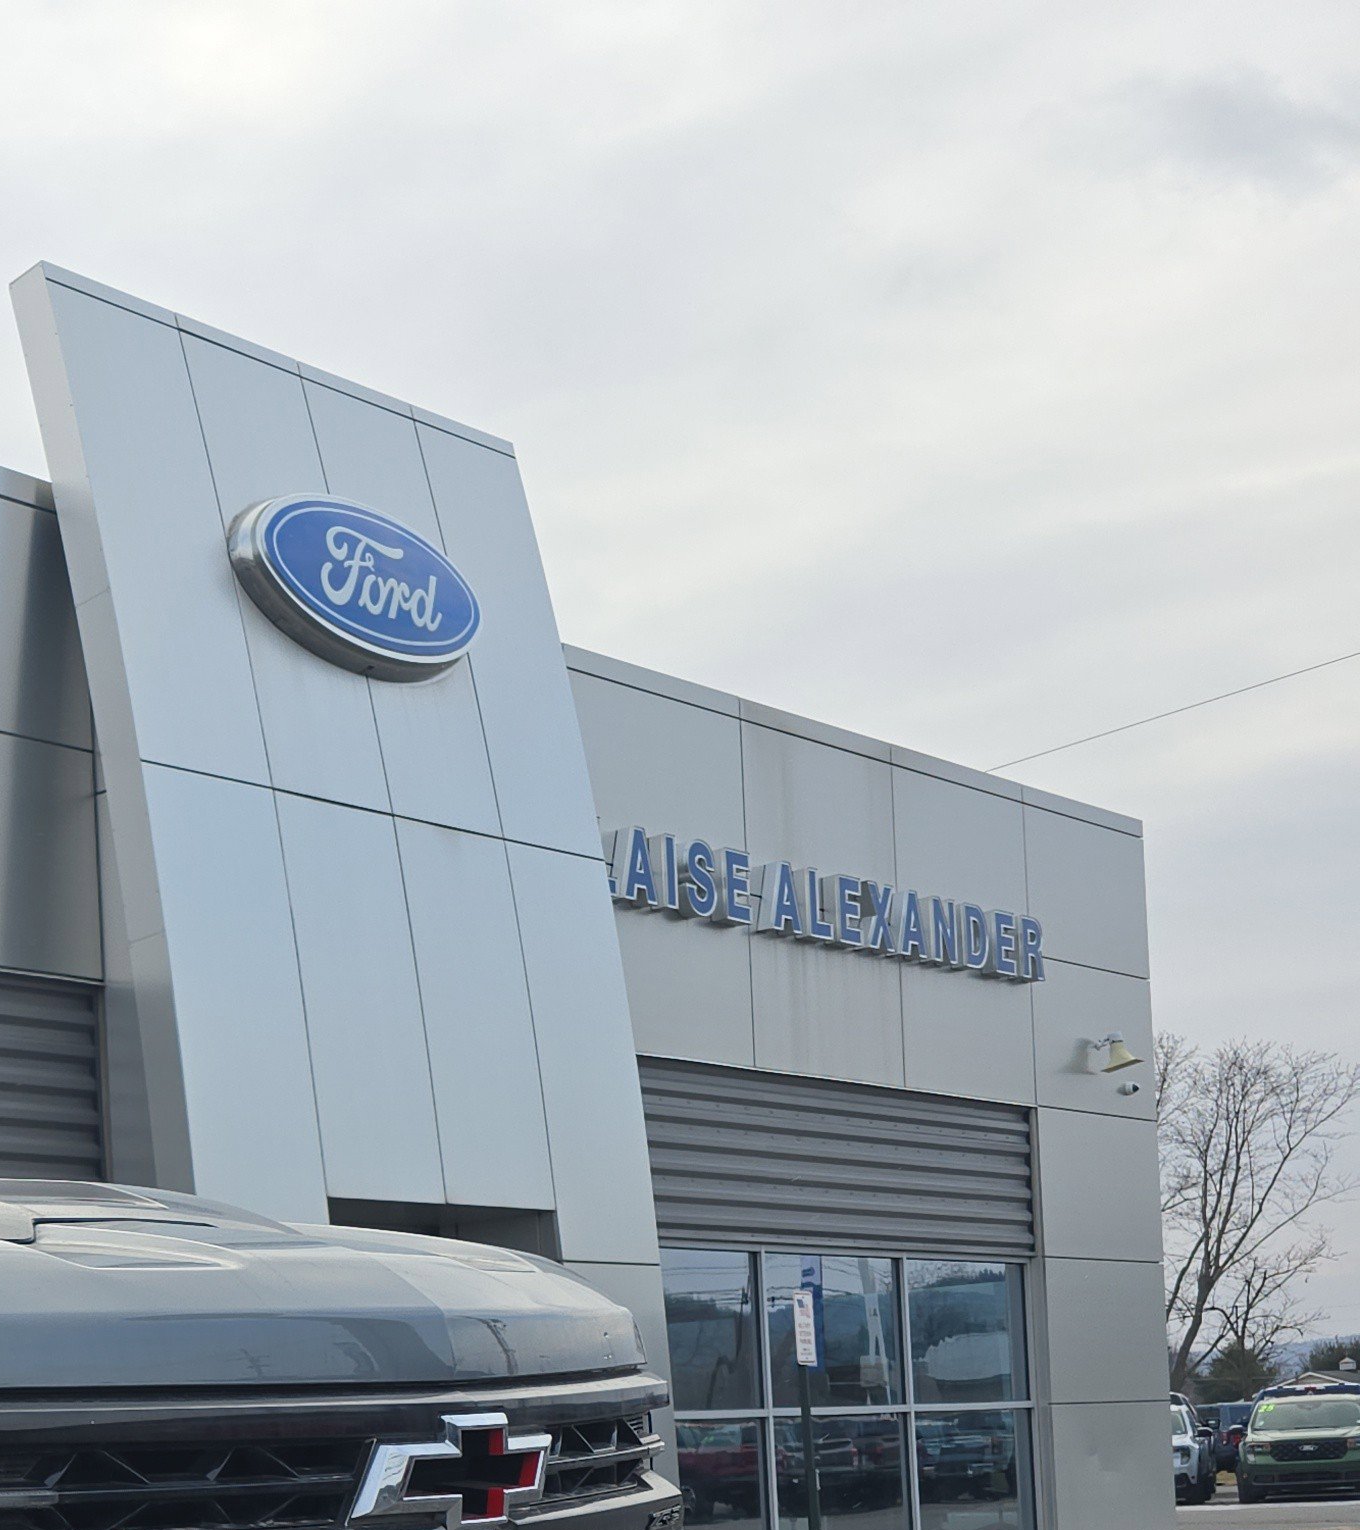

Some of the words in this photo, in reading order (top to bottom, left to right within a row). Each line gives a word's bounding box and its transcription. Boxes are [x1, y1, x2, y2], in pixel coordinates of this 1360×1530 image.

[321, 526, 442, 632] Ford
[608, 825, 752, 925] AISE
[772, 861, 1045, 981] ALEXANDER
